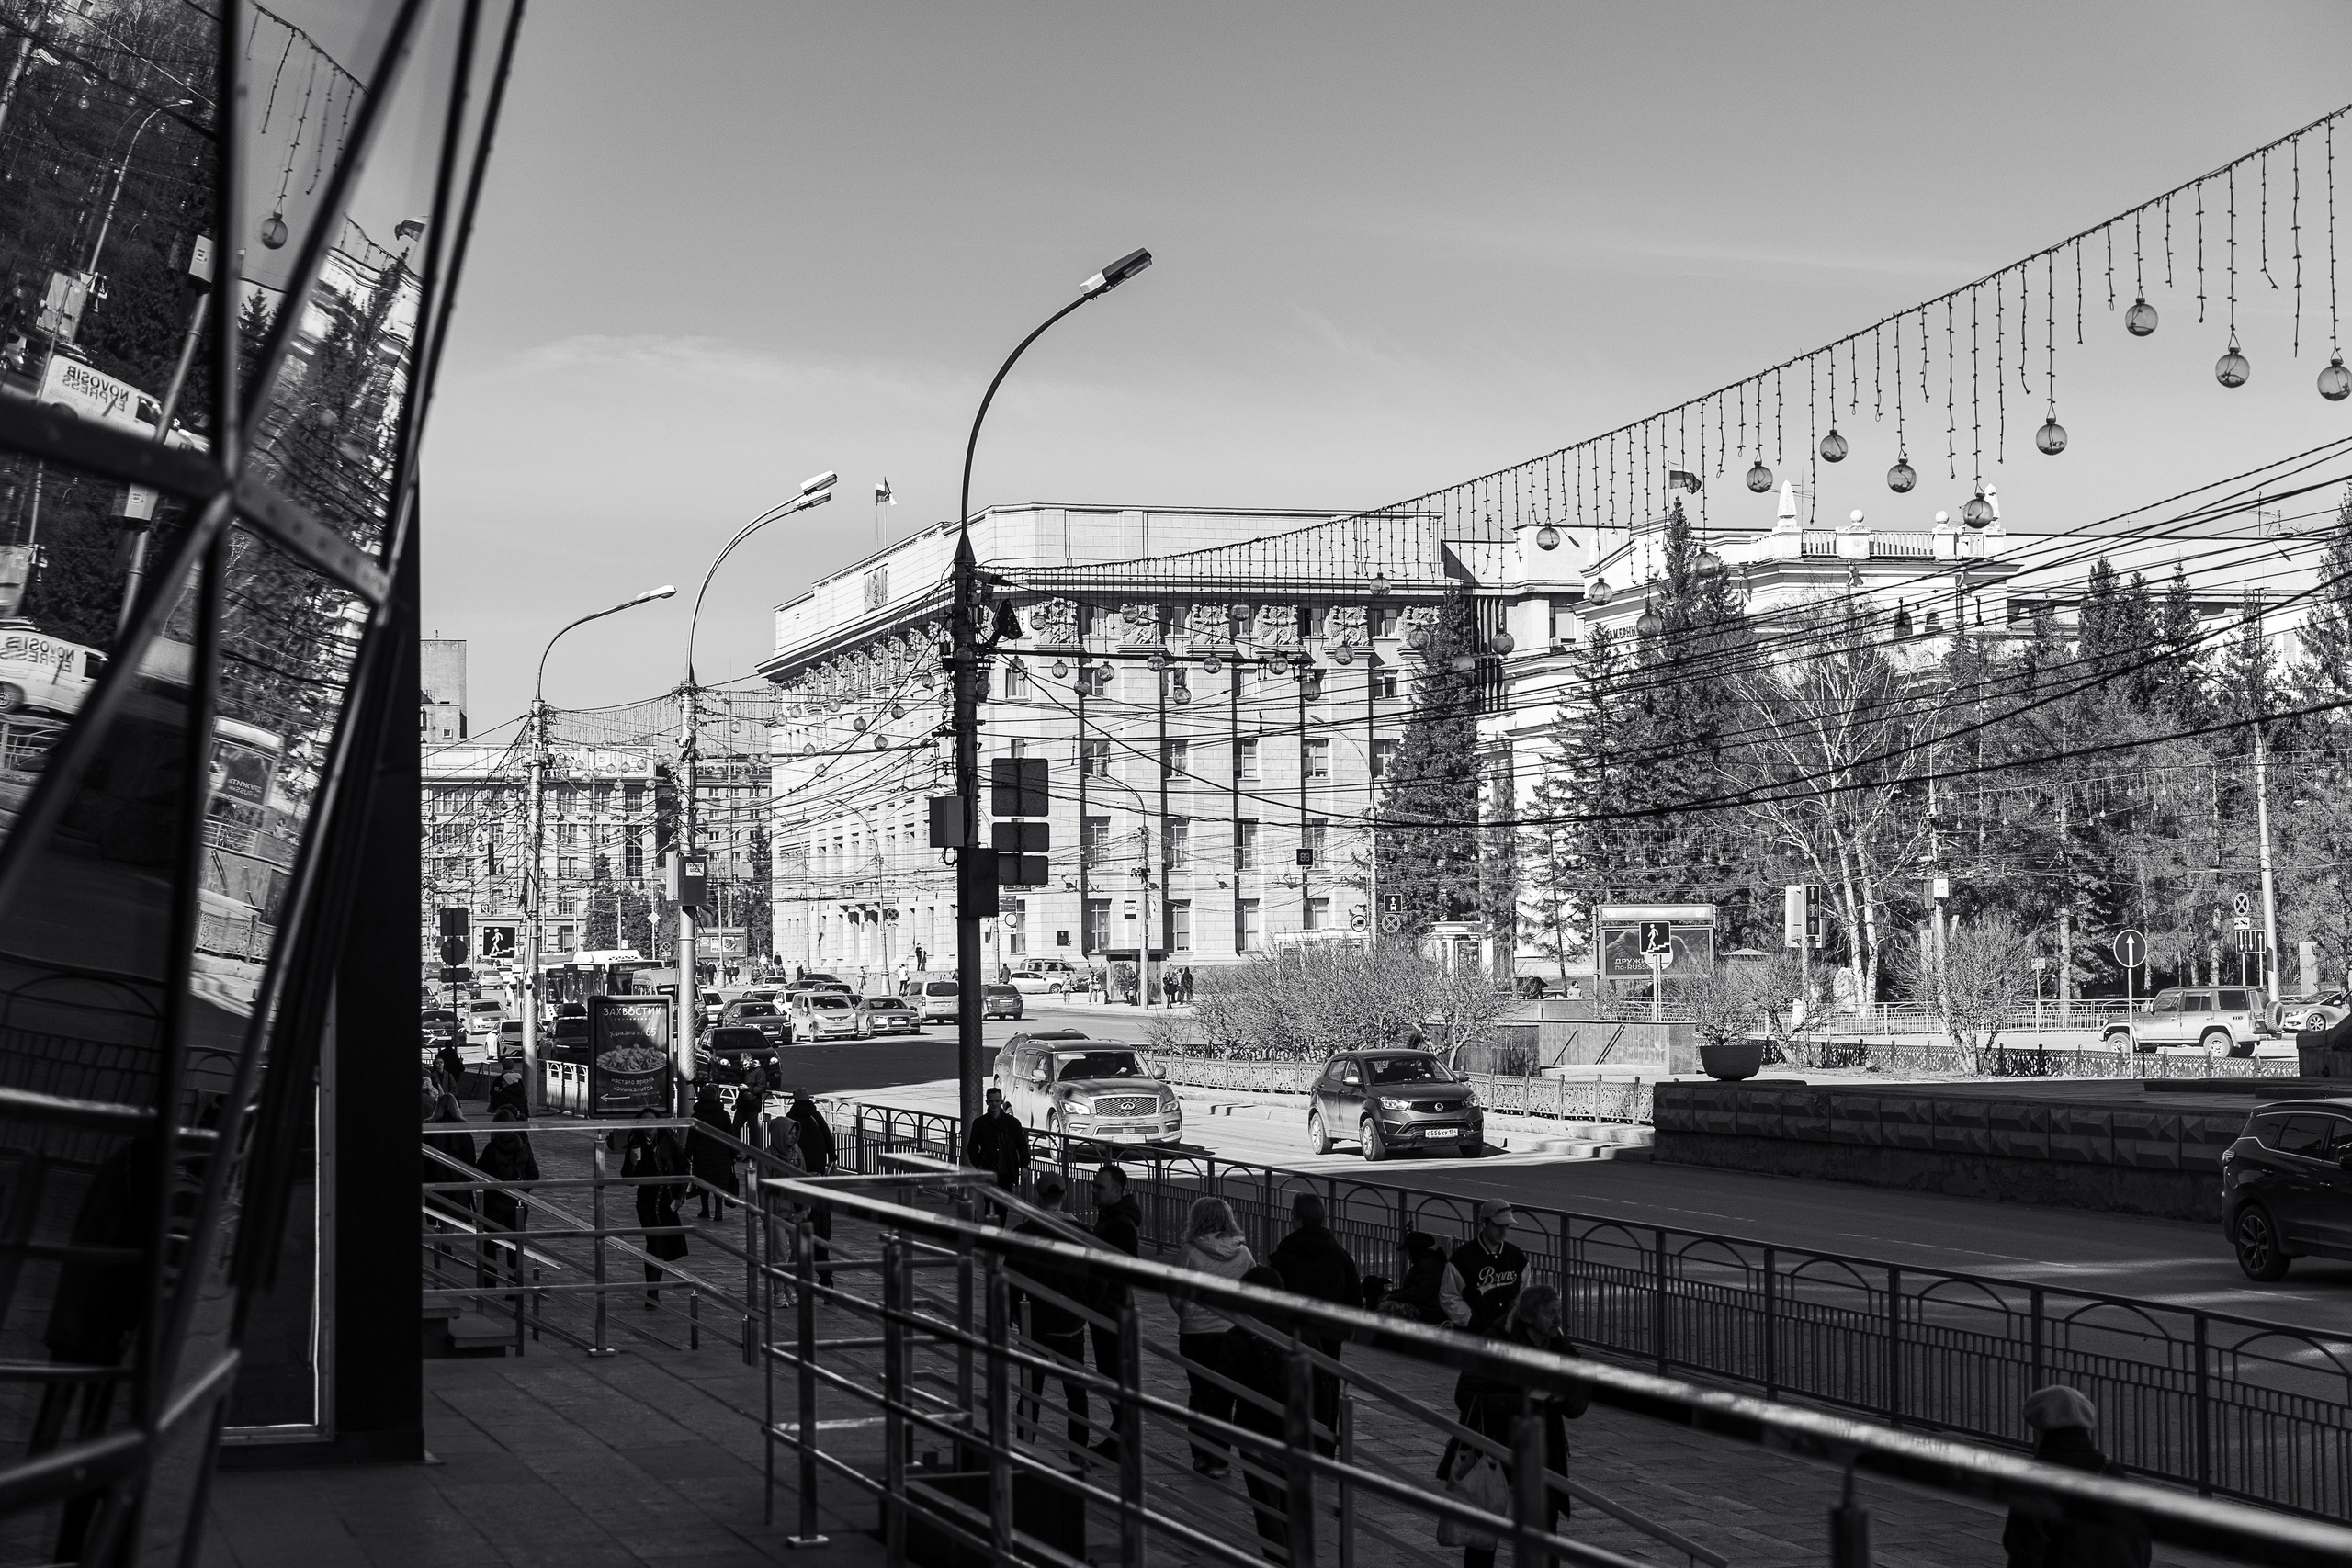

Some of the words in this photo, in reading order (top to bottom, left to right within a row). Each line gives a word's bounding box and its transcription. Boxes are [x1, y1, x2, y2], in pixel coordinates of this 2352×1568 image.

[603, 1006, 662, 1016] ЗАХВОСТИК
[645, 1026, 657, 1037] 65
[636, 1077, 655, 1087] время
